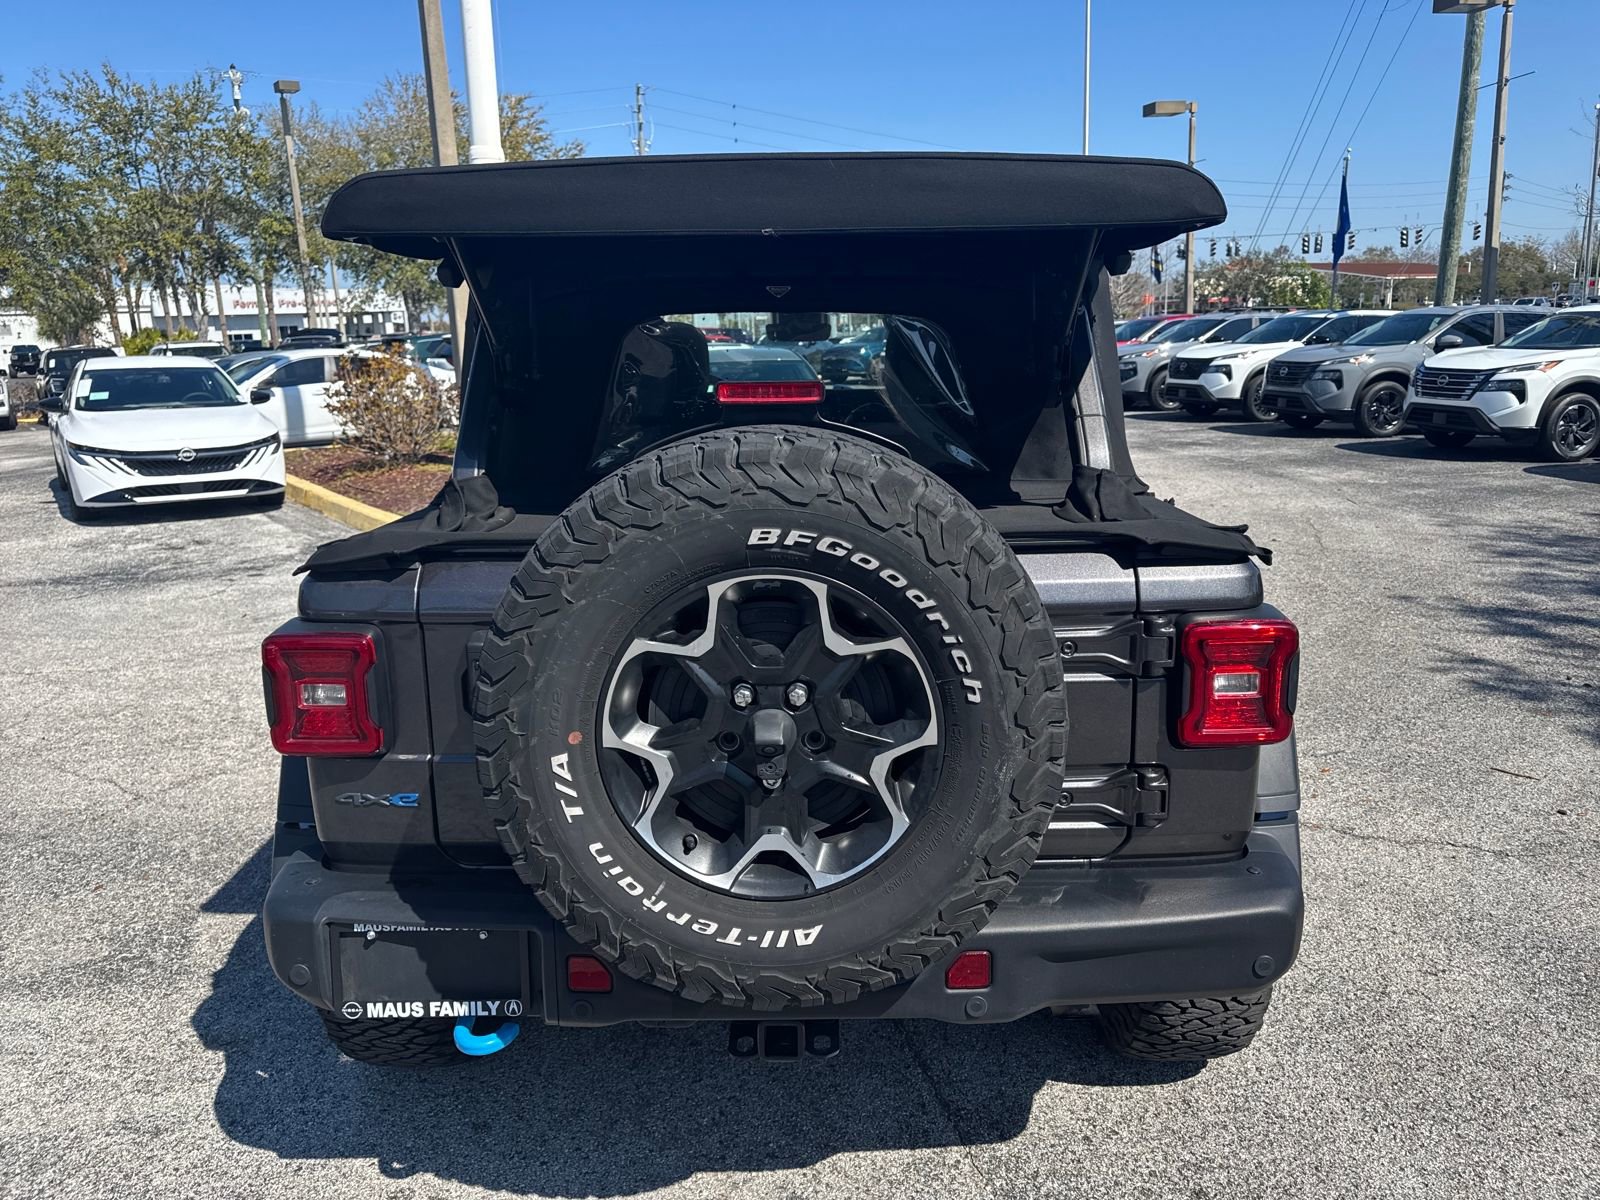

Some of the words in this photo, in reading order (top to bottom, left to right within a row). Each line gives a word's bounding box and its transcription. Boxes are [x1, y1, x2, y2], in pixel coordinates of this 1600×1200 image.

[747, 528, 983, 704] BFGoodrich
[551, 752, 584, 824] T/A
[588, 841, 824, 948] All-Terrain
[366, 1002, 425, 1018] MAUS
[429, 1001, 501, 1017] FAMILY
